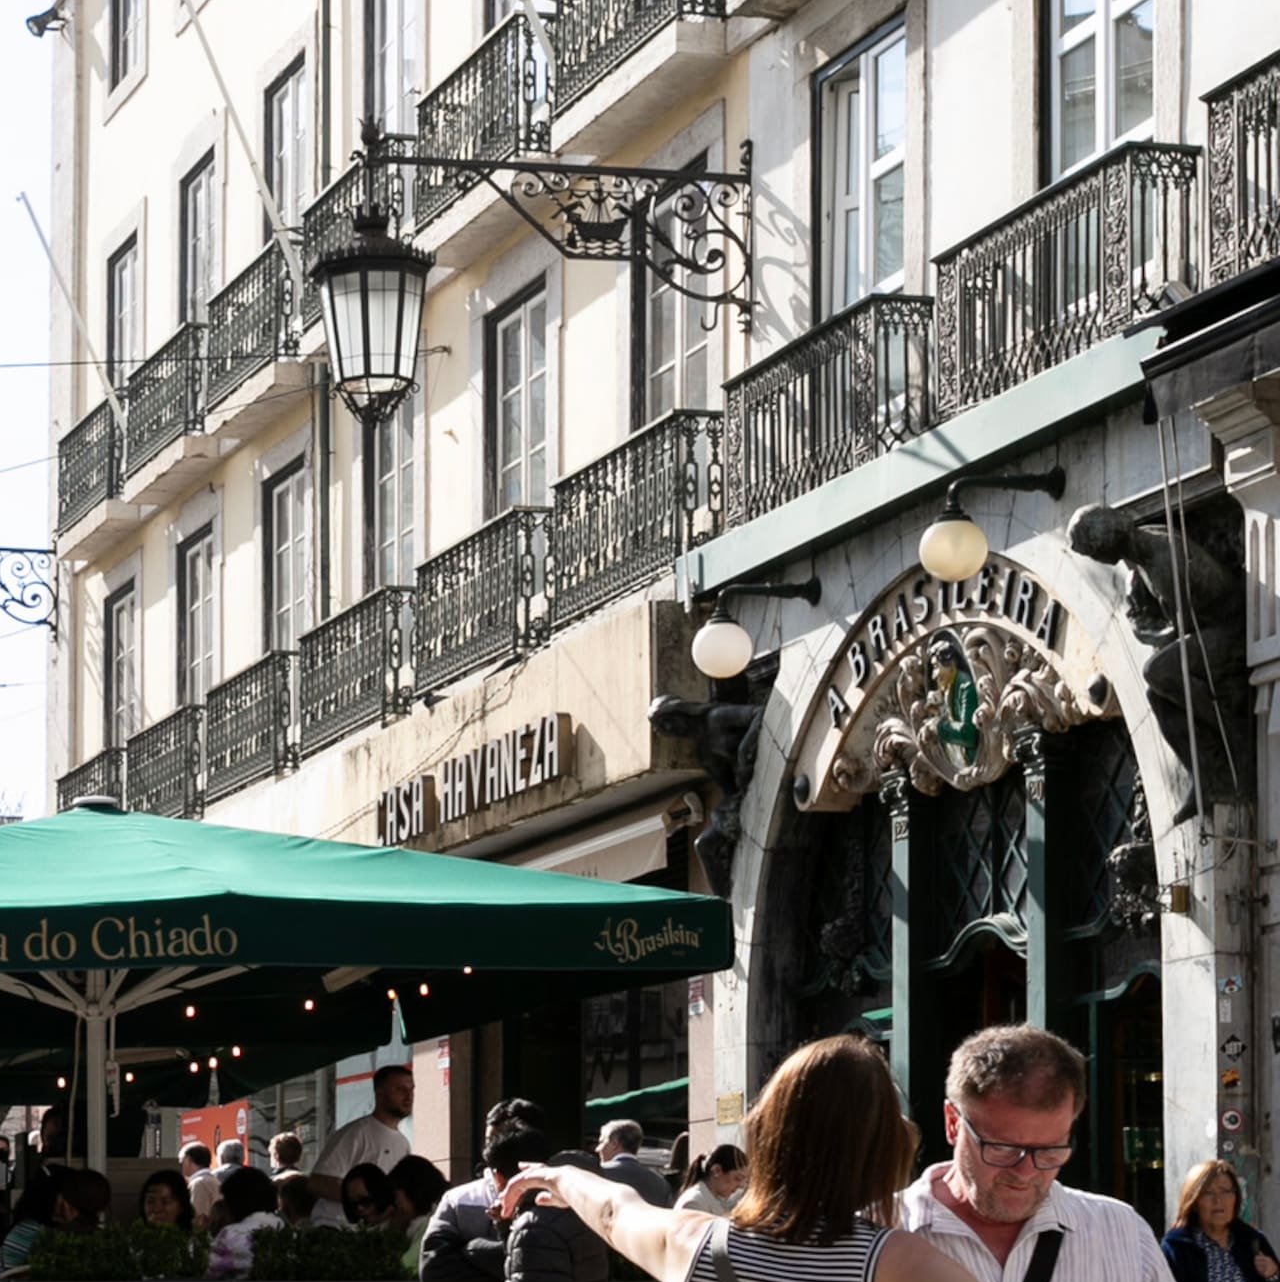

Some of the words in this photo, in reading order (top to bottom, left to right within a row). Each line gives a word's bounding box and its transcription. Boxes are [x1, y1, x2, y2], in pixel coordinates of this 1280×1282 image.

[827, 686, 850, 729] A
[847, 567, 1060, 686] BRASILEIRA
[376, 774, 426, 847] CASA
[439, 712, 560, 824] HAVANEZA
[23, 919, 77, 961] do
[90, 913, 238, 960] Chiado
[616, 917, 700, 964] Brasileira
